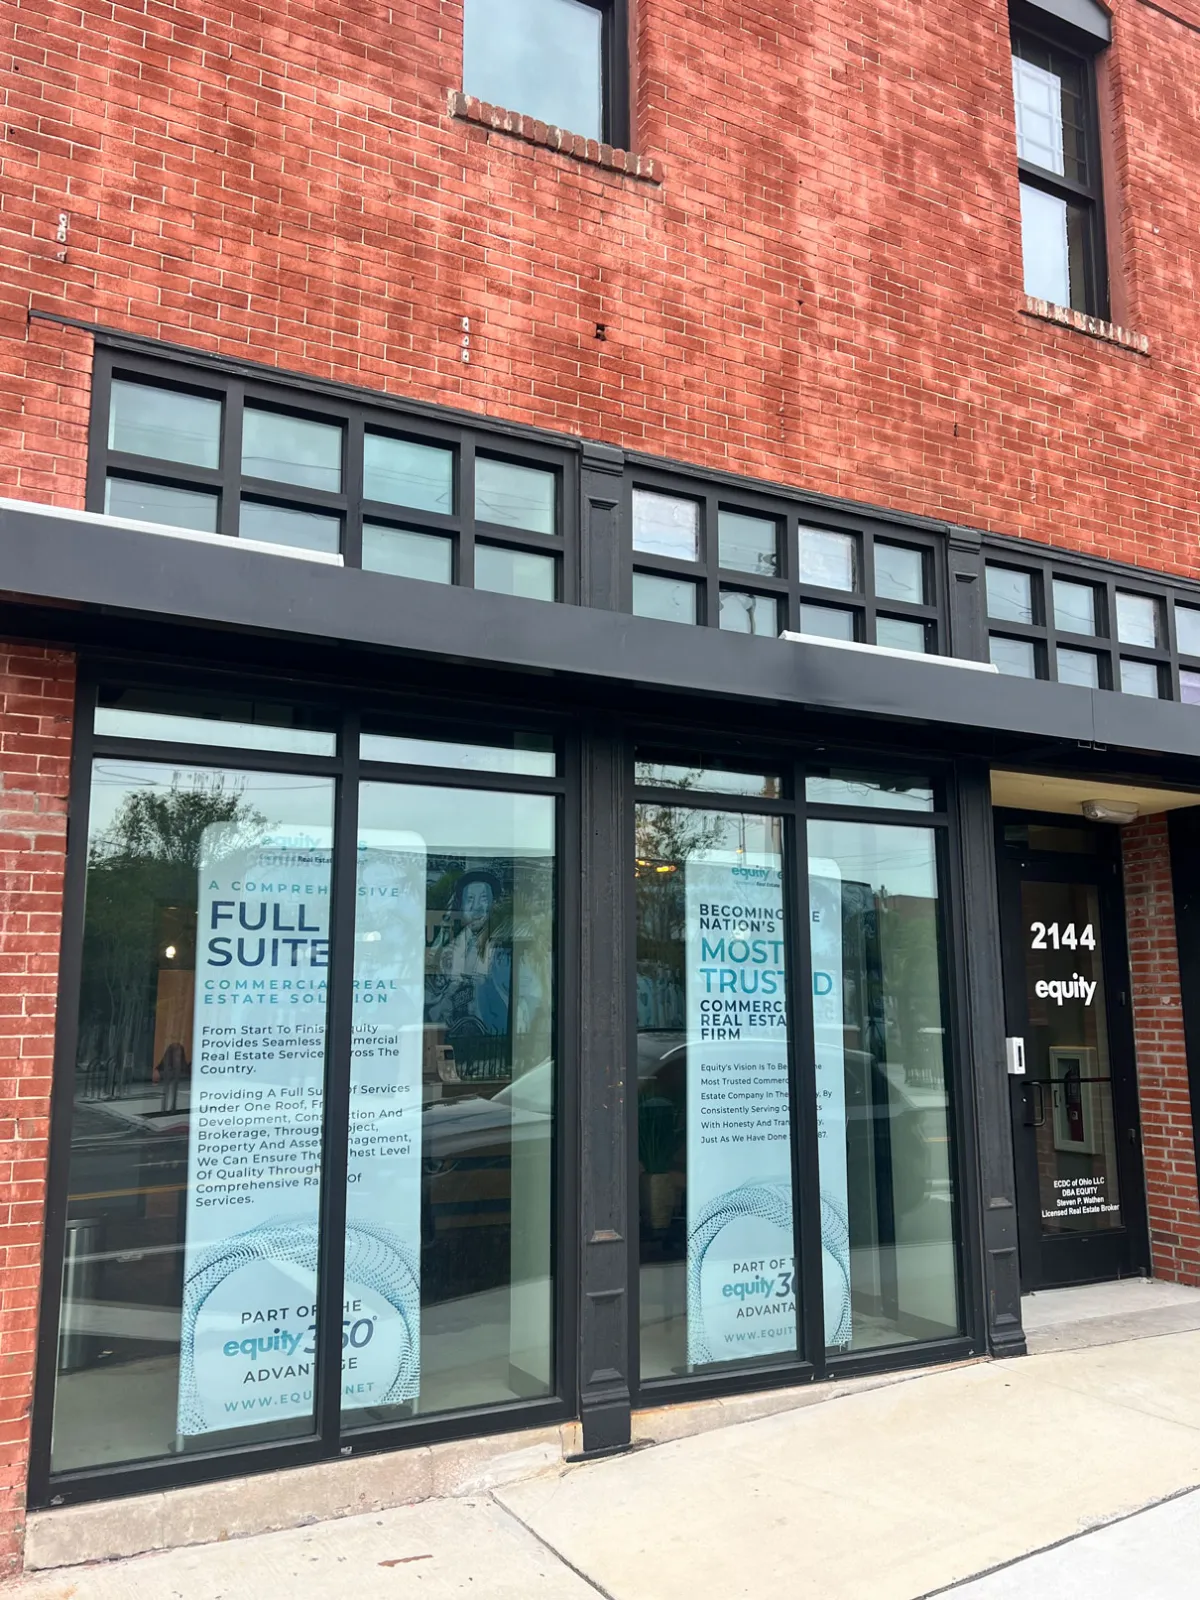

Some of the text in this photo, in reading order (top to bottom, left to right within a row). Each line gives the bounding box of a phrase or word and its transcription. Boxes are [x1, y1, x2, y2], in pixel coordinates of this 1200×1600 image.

[314, 856, 333, 864] Estat
[208, 880, 400, 898] A COMPREHSIVE
[210, 900, 320, 932] FULL
[700, 917, 776, 933] NATION'S
[1030, 921, 1096, 951] 2144
[206, 936, 330, 968] SUITE
[701, 937, 784, 965] MOST
[204, 979, 398, 991] COMMERCIA REAL
[699, 967, 834, 997] TRUSD
[1035, 972, 1097, 1006] equity
[204, 992, 389, 1005] ESTATE SOLION
[700, 999, 787, 1013] COMMERCI
[700, 1013, 788, 1027] REAL ESTA
[202, 1023, 378, 1036] From Start To Finis uity
[700, 1028, 741, 1041] FIRM
[201, 1035, 399, 1049] Provides Seamless mercial
[201, 1047, 400, 1062] Real Estate Service ross The
[200, 1064, 257, 1076] Country.
[700, 1062, 732, 1073] Equity's
[733, 1062, 757, 1072] Vision
[758, 1063, 766, 1071] Is
[766, 1062, 777, 1071] To
[700, 1076, 790, 1087] Most Trusted Commerc
[199, 1089, 263, 1102] Providing
[266, 1088, 277, 1099] A
[280, 1087, 304, 1098] Full
[360, 1083, 411, 1095] Services
[700, 1092, 726, 1101] Estate
[727, 1091, 764, 1102] Company
[765, 1091, 774, 1100] In
[775, 1090, 789, 1099] The
[822, 1089, 833, 1099] By
[199, 1099, 325, 1114] Under One Roof, Fr
[700, 1105, 750, 1116] Consistently
[751, 1104, 780, 1114] Serving
[198, 1108, 404, 1128] Development, Constion And
[700, 1120, 721, 1130] With
[722, 1119, 755, 1130] Honesty
[756, 1119, 772, 1128] And
[198, 1127, 271, 1141] Brokerage,
[348, 1122, 379, 1135] oject,
[700, 1136, 718, 1144] Just
[720, 1135, 730, 1143] As
[732, 1135, 745, 1143] We
[746, 1134, 766, 1142] Have
[767, 1133, 788, 1141] Done
[197, 1141, 256, 1155] Property
[259, 1139, 286, 1151] And
[348, 1134, 412, 1147] nagement,
[197, 1145, 411, 1168] We Can Ensure The hest Level
[196, 1164, 322, 1181] Of Quality Through
[195, 1178, 300, 1195] Comprehensive
[346, 1173, 362, 1185] Of
[1053, 1177, 1105, 1188] ECDC of Ohio LLC
[1061, 1186, 1098, 1197] DBA EQUITY
[195, 1195, 255, 1208] Services.
[1056, 1198, 1077, 1207] Steven
[1083, 1196, 1105, 1204] Wathen
[1041, 1203, 1120, 1218] Licensed Real Estate Broker
[733, 1261, 766, 1274] PART
[769, 1258, 786, 1271] OF
[241, 1307, 290, 1325] PART
[342, 1299, 362, 1313] HE
[736, 1302, 797, 1319] ADVANTA
[724, 1326, 797, 1343] WWW.EQUIT
[243, 1357, 358, 1384] ADVANGE
[224, 1382, 375, 1412] WWW.EQUNET
